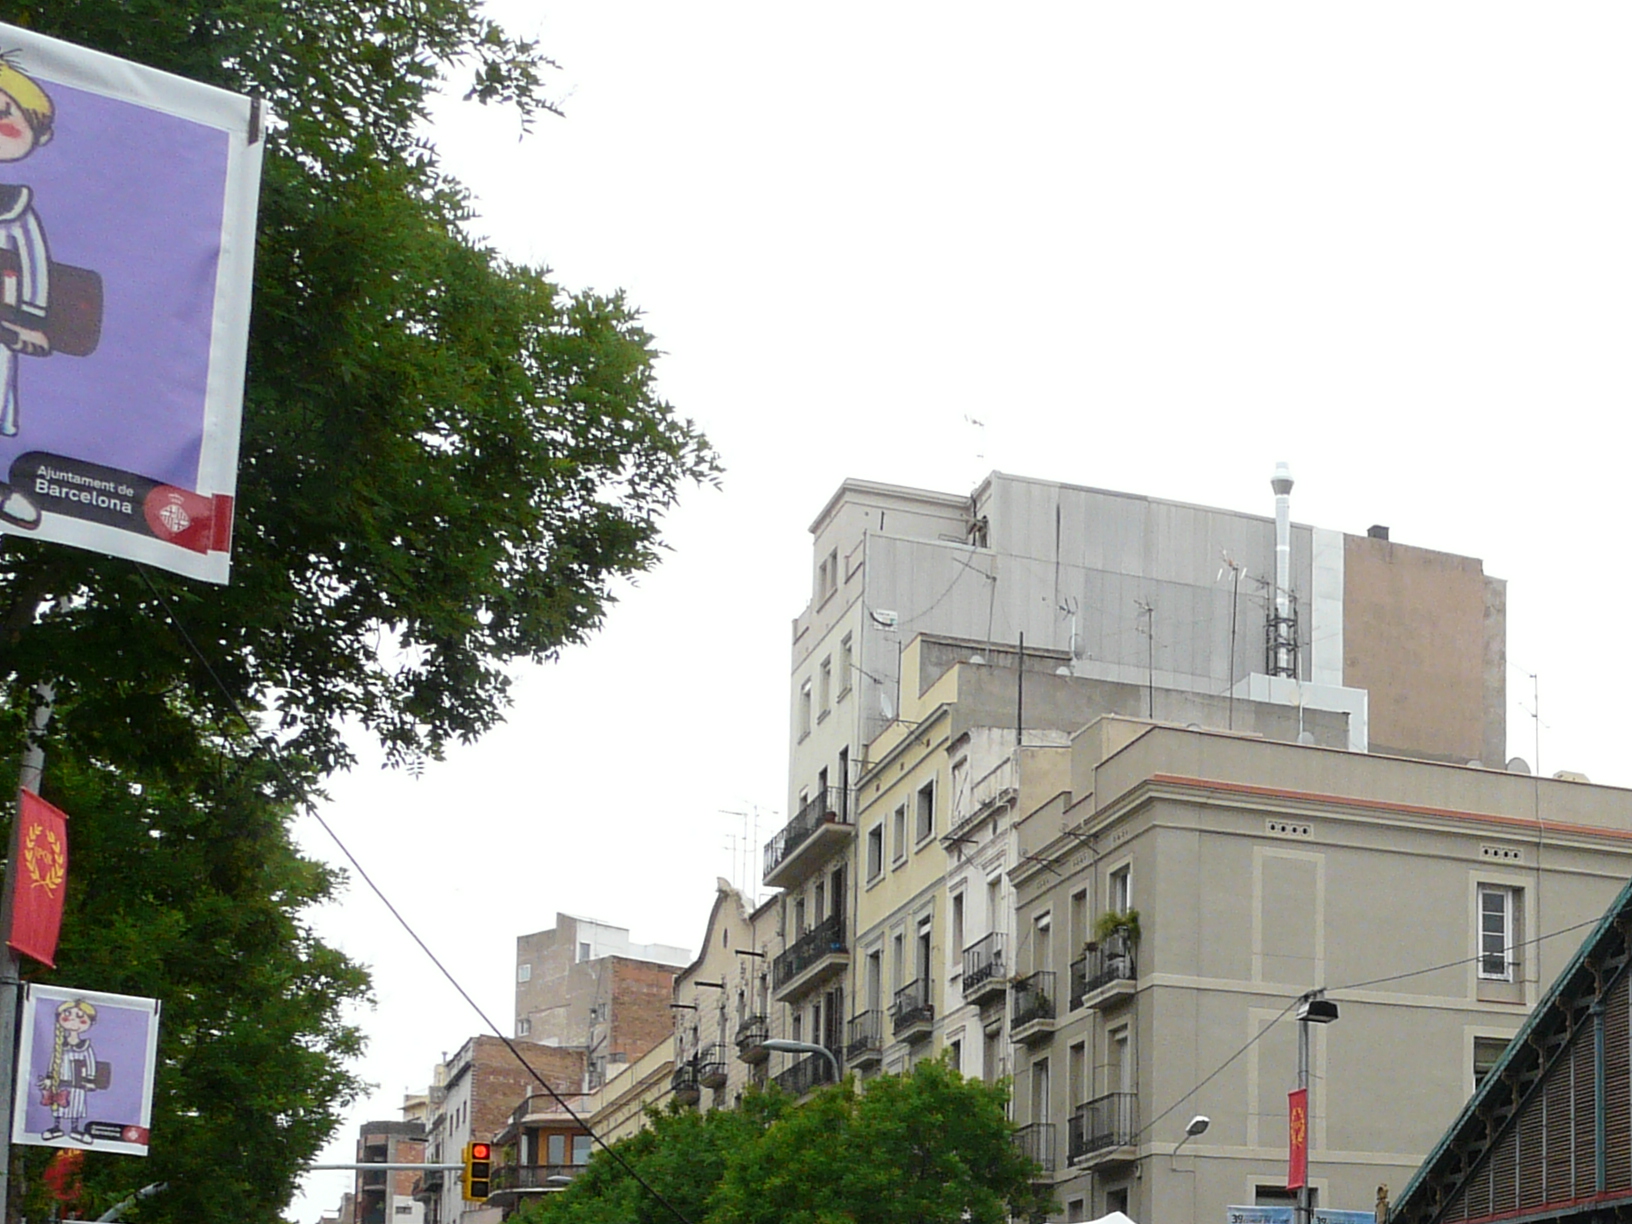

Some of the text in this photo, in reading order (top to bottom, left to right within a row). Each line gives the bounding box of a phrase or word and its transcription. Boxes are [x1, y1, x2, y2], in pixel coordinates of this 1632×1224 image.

[35, 477, 133, 515] Barcelona
[37, 465, 134, 498] Ajuntament de
